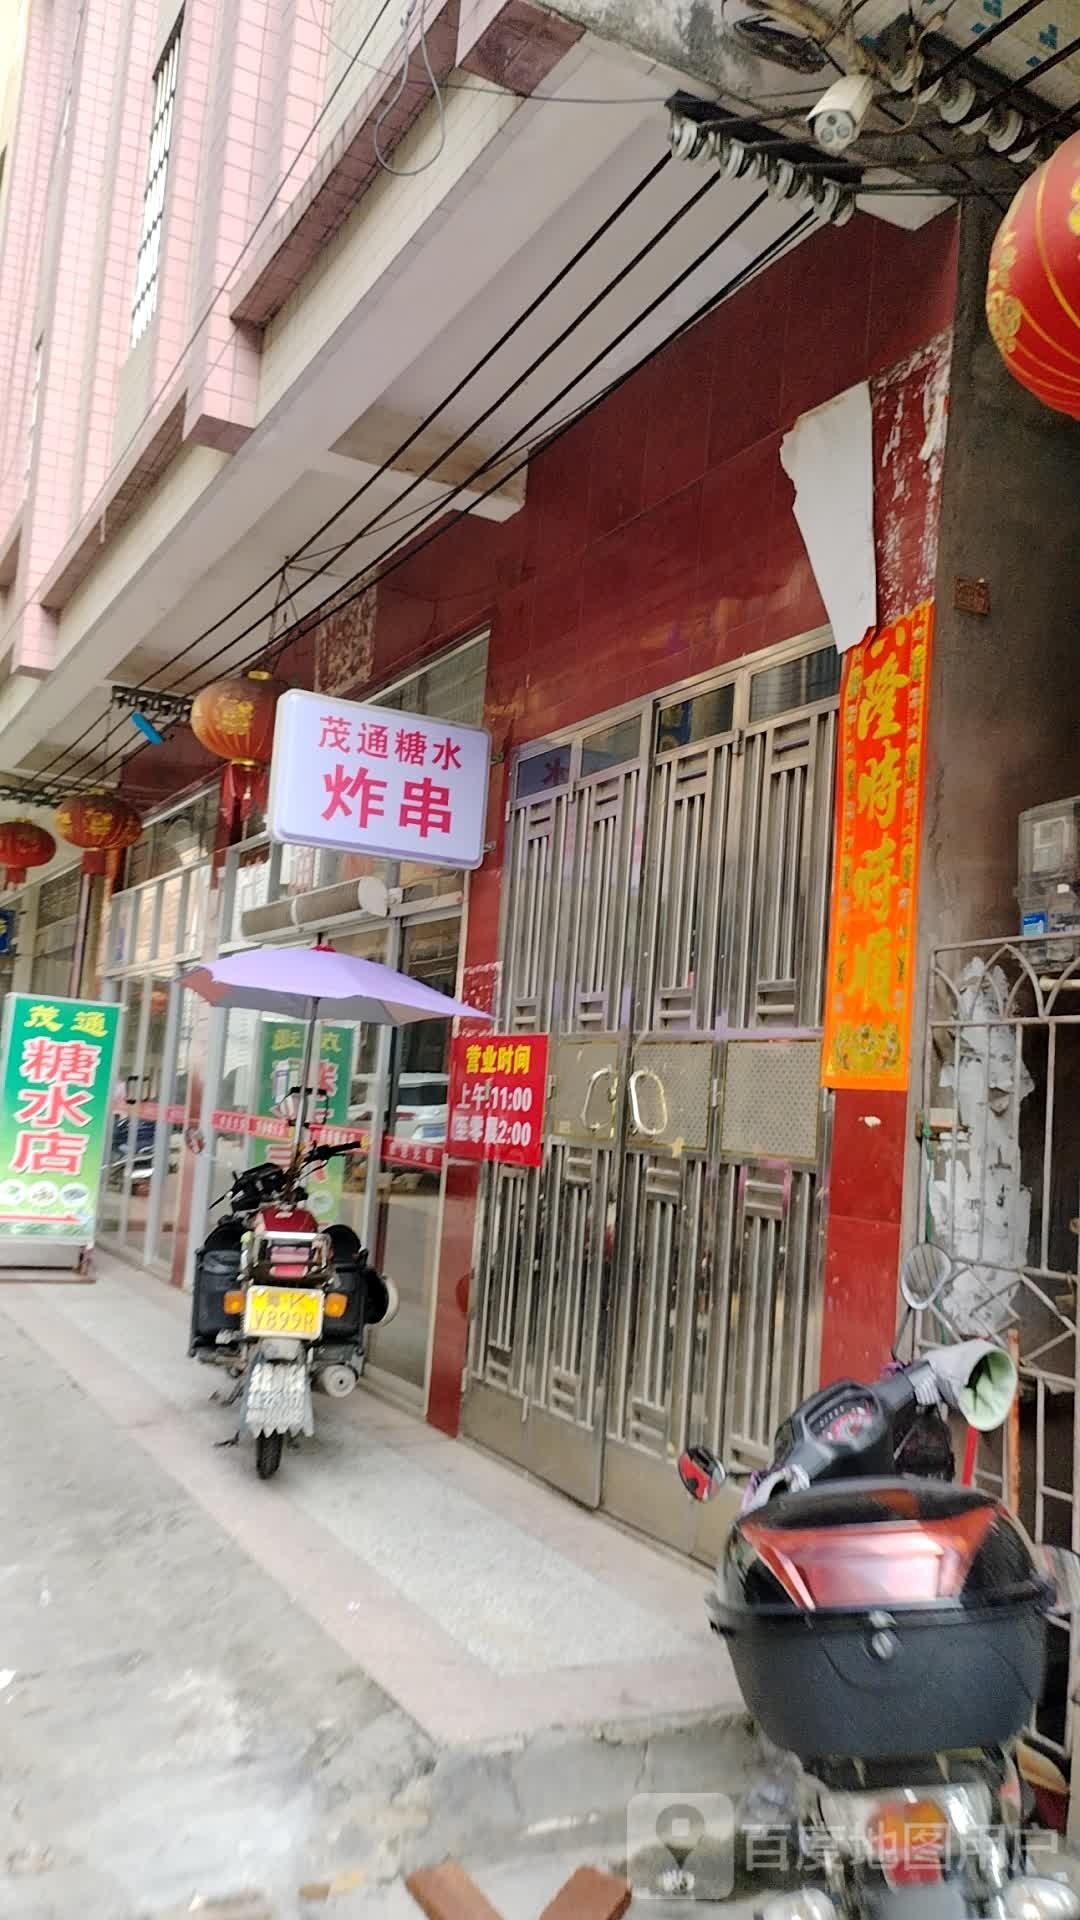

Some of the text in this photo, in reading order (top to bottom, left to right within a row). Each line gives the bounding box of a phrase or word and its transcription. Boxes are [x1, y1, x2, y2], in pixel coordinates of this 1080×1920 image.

[318, 715, 463, 771] 茂通糖水
[321, 763, 453, 838] 炸串
[23, 1004, 109, 1038] 茂通
[465, 1044, 532, 1075] 营业时间
[11, 1037, 101, 1176] 糖水店
